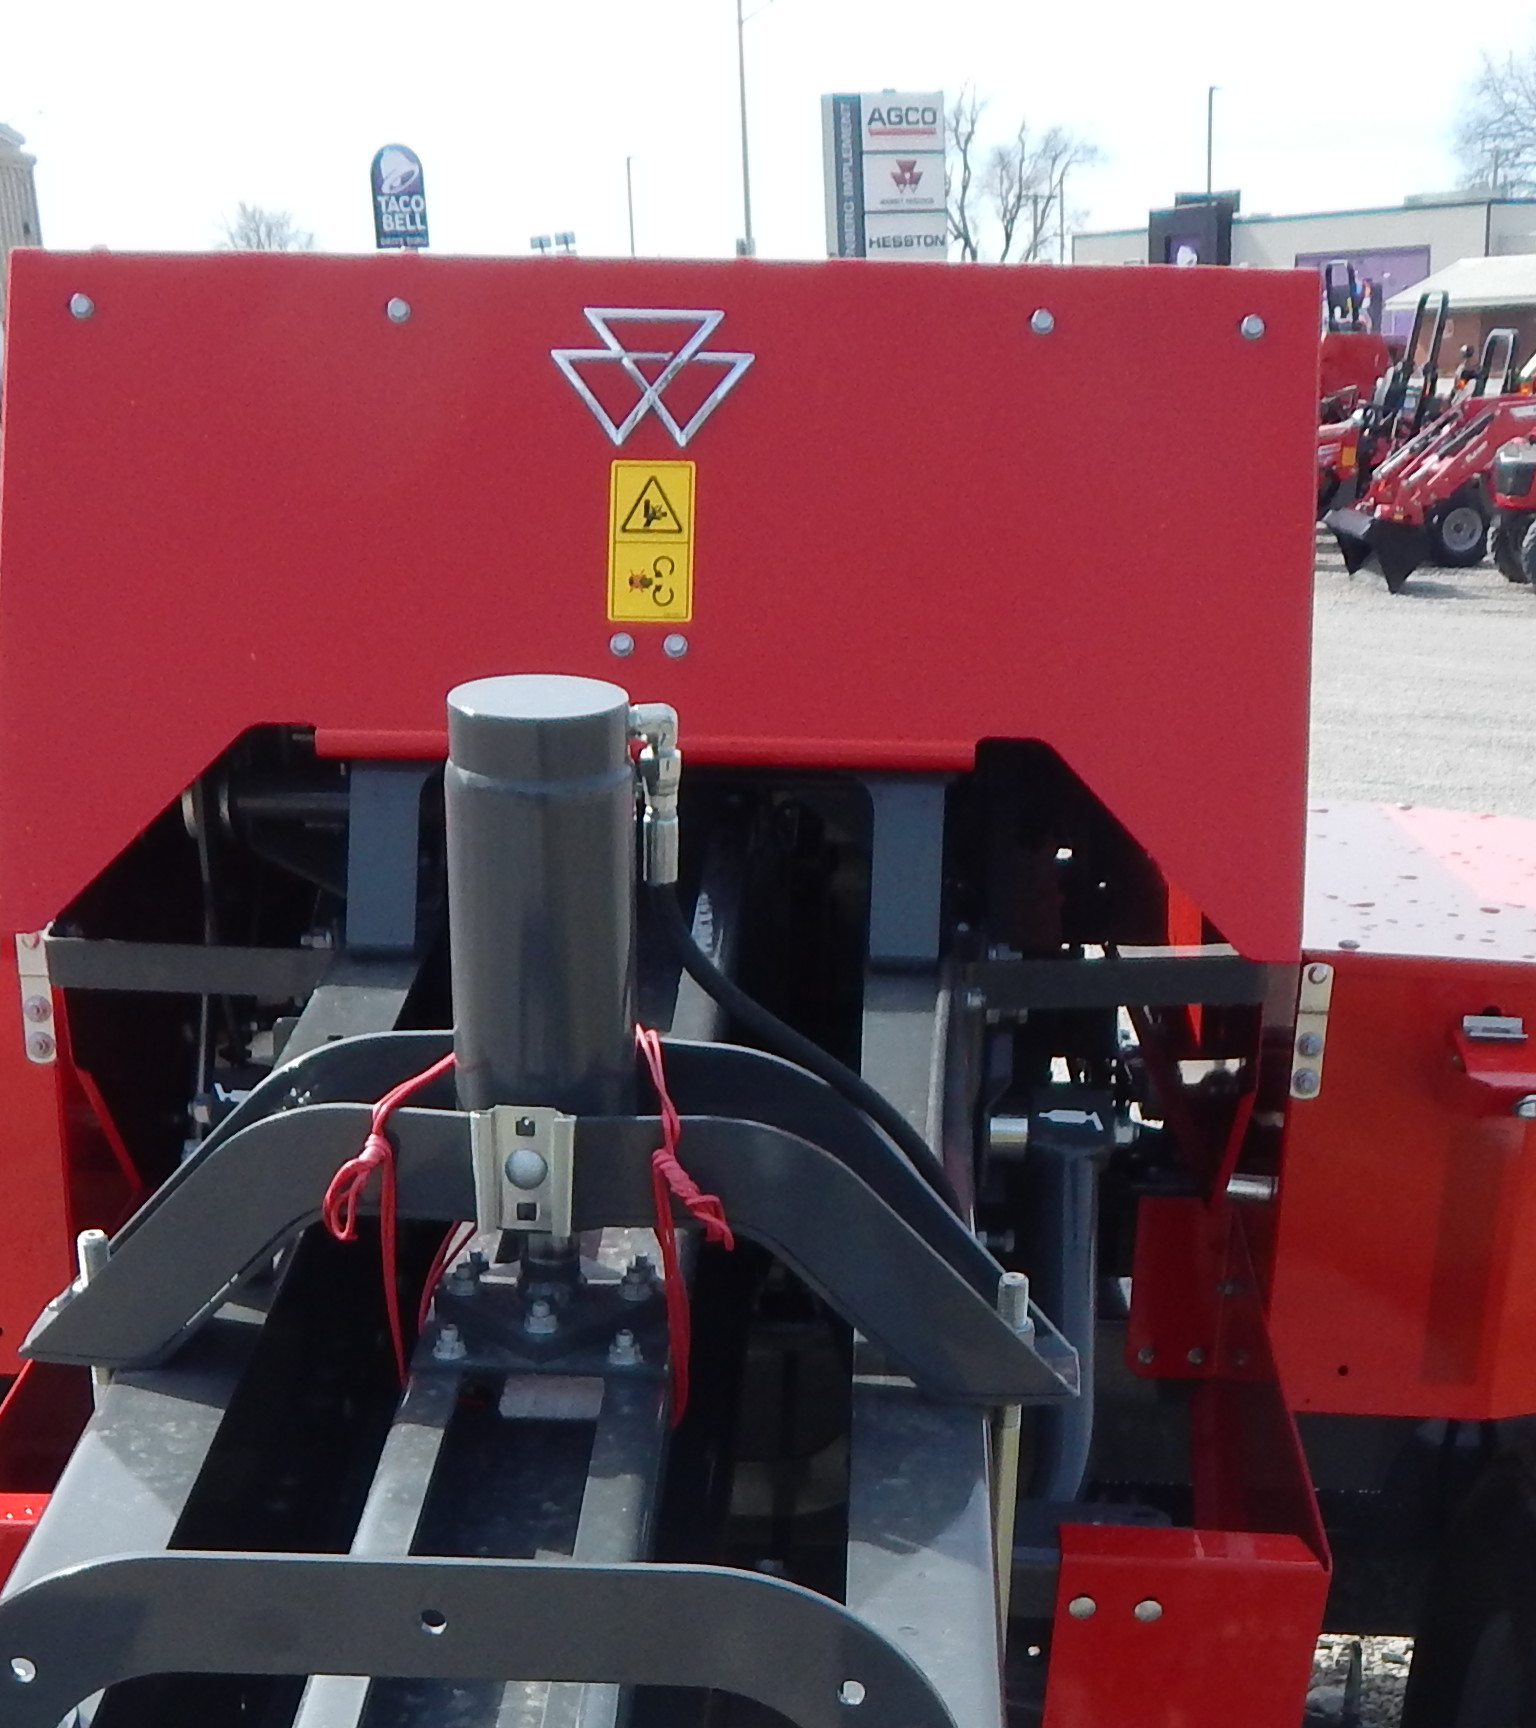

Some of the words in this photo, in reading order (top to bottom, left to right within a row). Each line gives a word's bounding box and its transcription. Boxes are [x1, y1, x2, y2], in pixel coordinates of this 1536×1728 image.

[867, 107, 938, 126] AGCO
[377, 195, 425, 213] TACO
[382, 213, 426, 231] BELL
[868, 235, 946, 249] HESSTON
